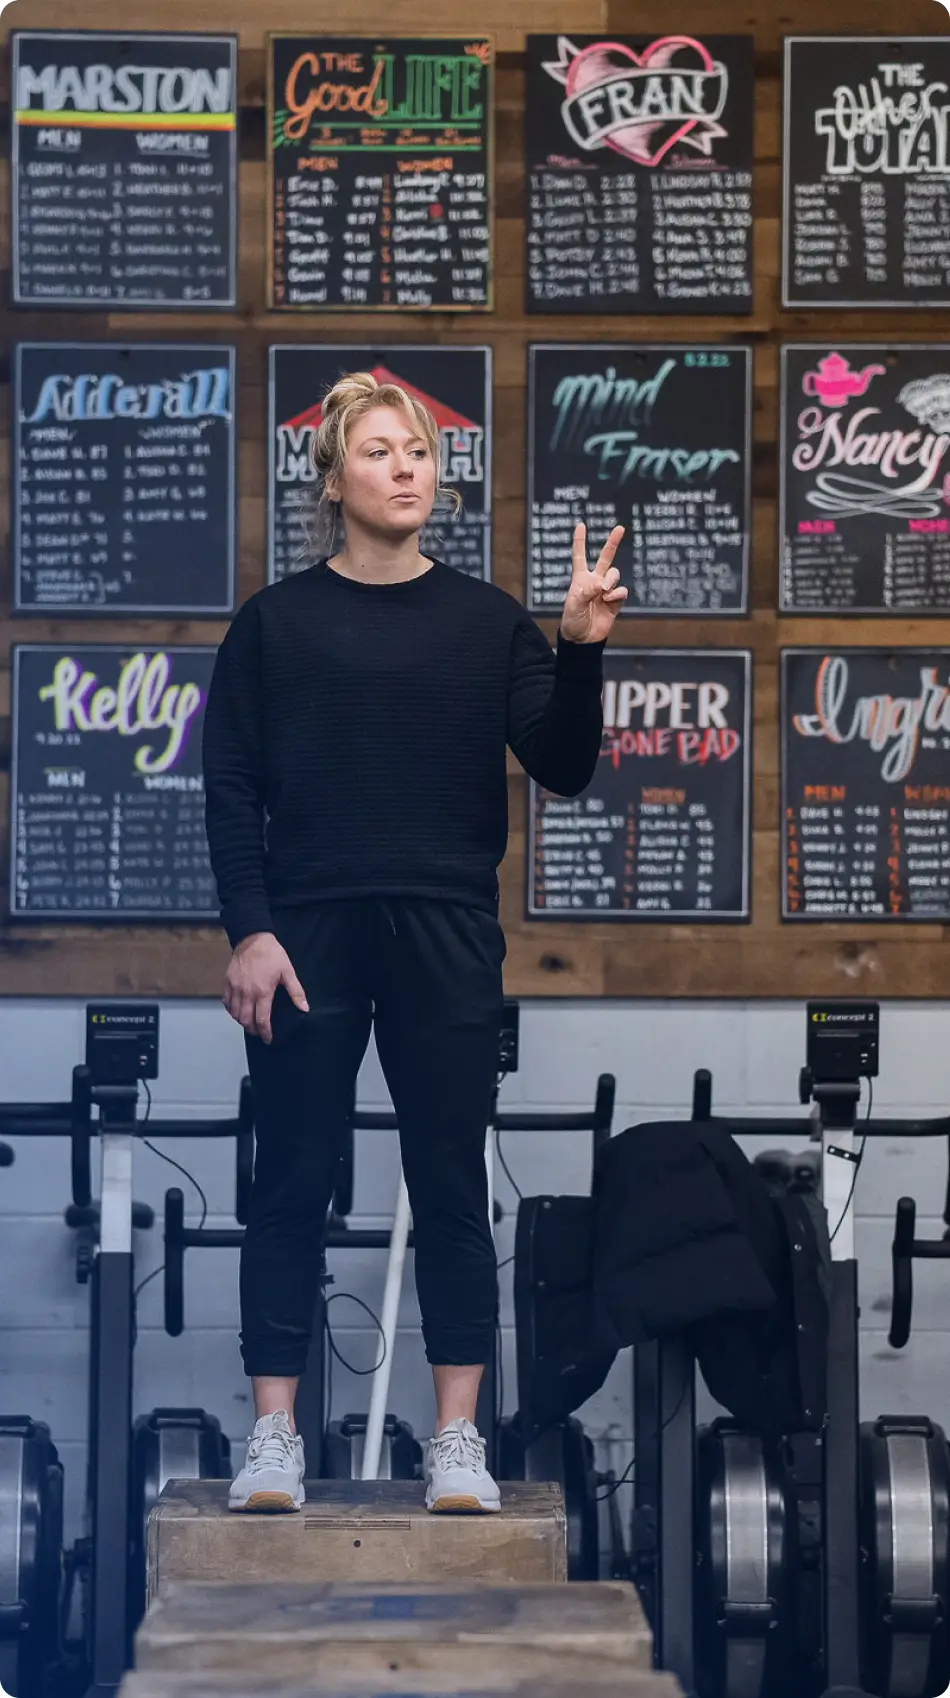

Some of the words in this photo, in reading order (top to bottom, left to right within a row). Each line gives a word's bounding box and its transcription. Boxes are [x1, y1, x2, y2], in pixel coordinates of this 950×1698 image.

[320, 53, 364, 73] THE
[878, 63, 925, 87] THE
[19, 65, 231, 113] MARSTON
[284, 52, 389, 139] Good
[578, 75, 706, 138] FRAN
[833, 77, 948, 141] Other
[37, 130, 82, 146] MEN
[136, 133, 209, 150] WOMEN
[298, 157, 338, 171] MEN
[19, 365, 233, 423] Adderall
[792, 407, 950, 496] Nancy
[553, 485, 590, 500] MEN
[657, 488, 717, 503] WOMEN
[38, 652, 207, 773] Kelly
[603, 680, 729, 729] IPPER
[677, 728, 740, 767] BAD
[47, 771, 85, 787] MEN
[804, 785, 846, 799] MEN
[827, 1014, 866, 1022] concept
[868, 1013, 874, 1021] 2
